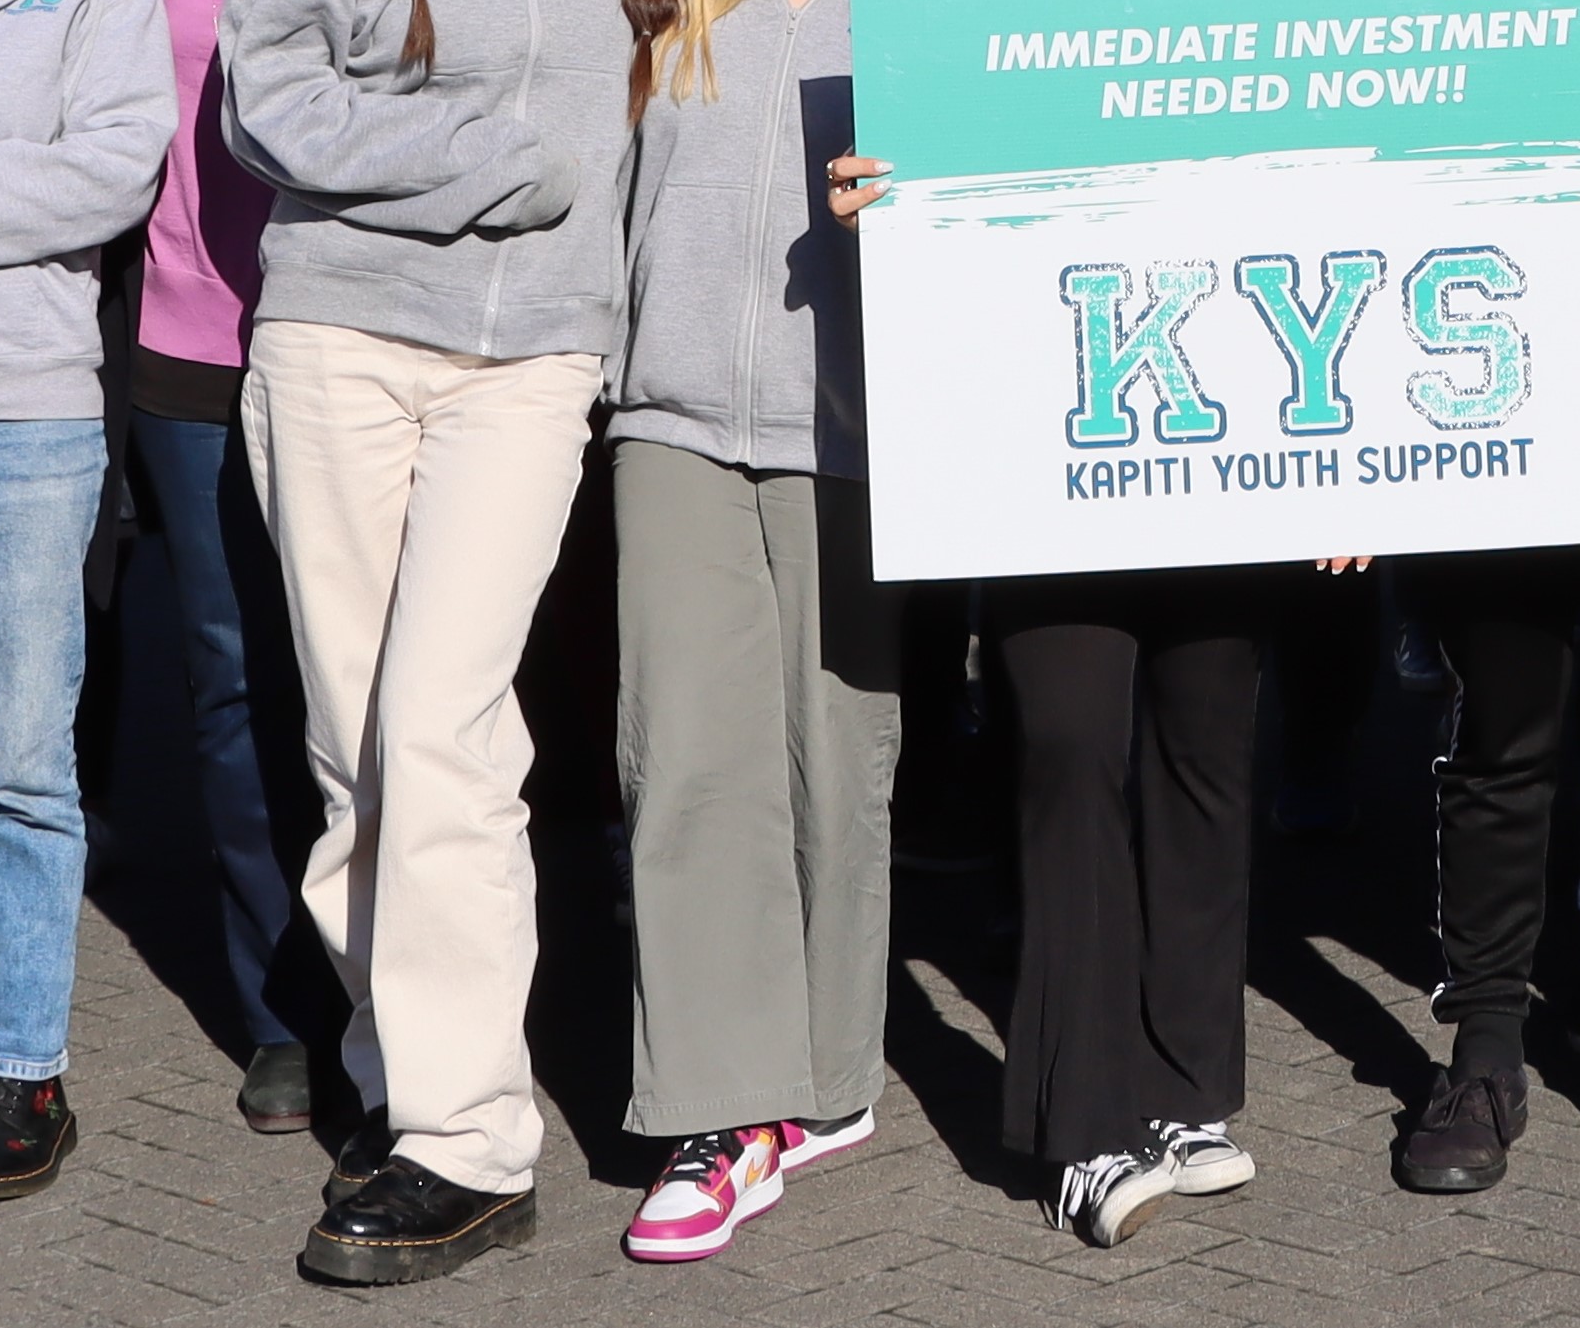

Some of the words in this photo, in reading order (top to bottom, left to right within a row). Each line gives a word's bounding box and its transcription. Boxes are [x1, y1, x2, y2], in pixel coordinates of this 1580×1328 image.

[985, 22, 1258, 74] IMMEDIATE
[1273, 8, 1578, 60] INVESTMENT
[1100, 70, 1291, 120] NEEDED
[1306, 63, 1467, 111] NOW!!
[1058, 244, 1532, 449] KYS
[1064, 455, 1193, 501] KAPITI
[1211, 448, 1340, 492] YOUTH
[1357, 437, 1535, 485] SUPPORT
